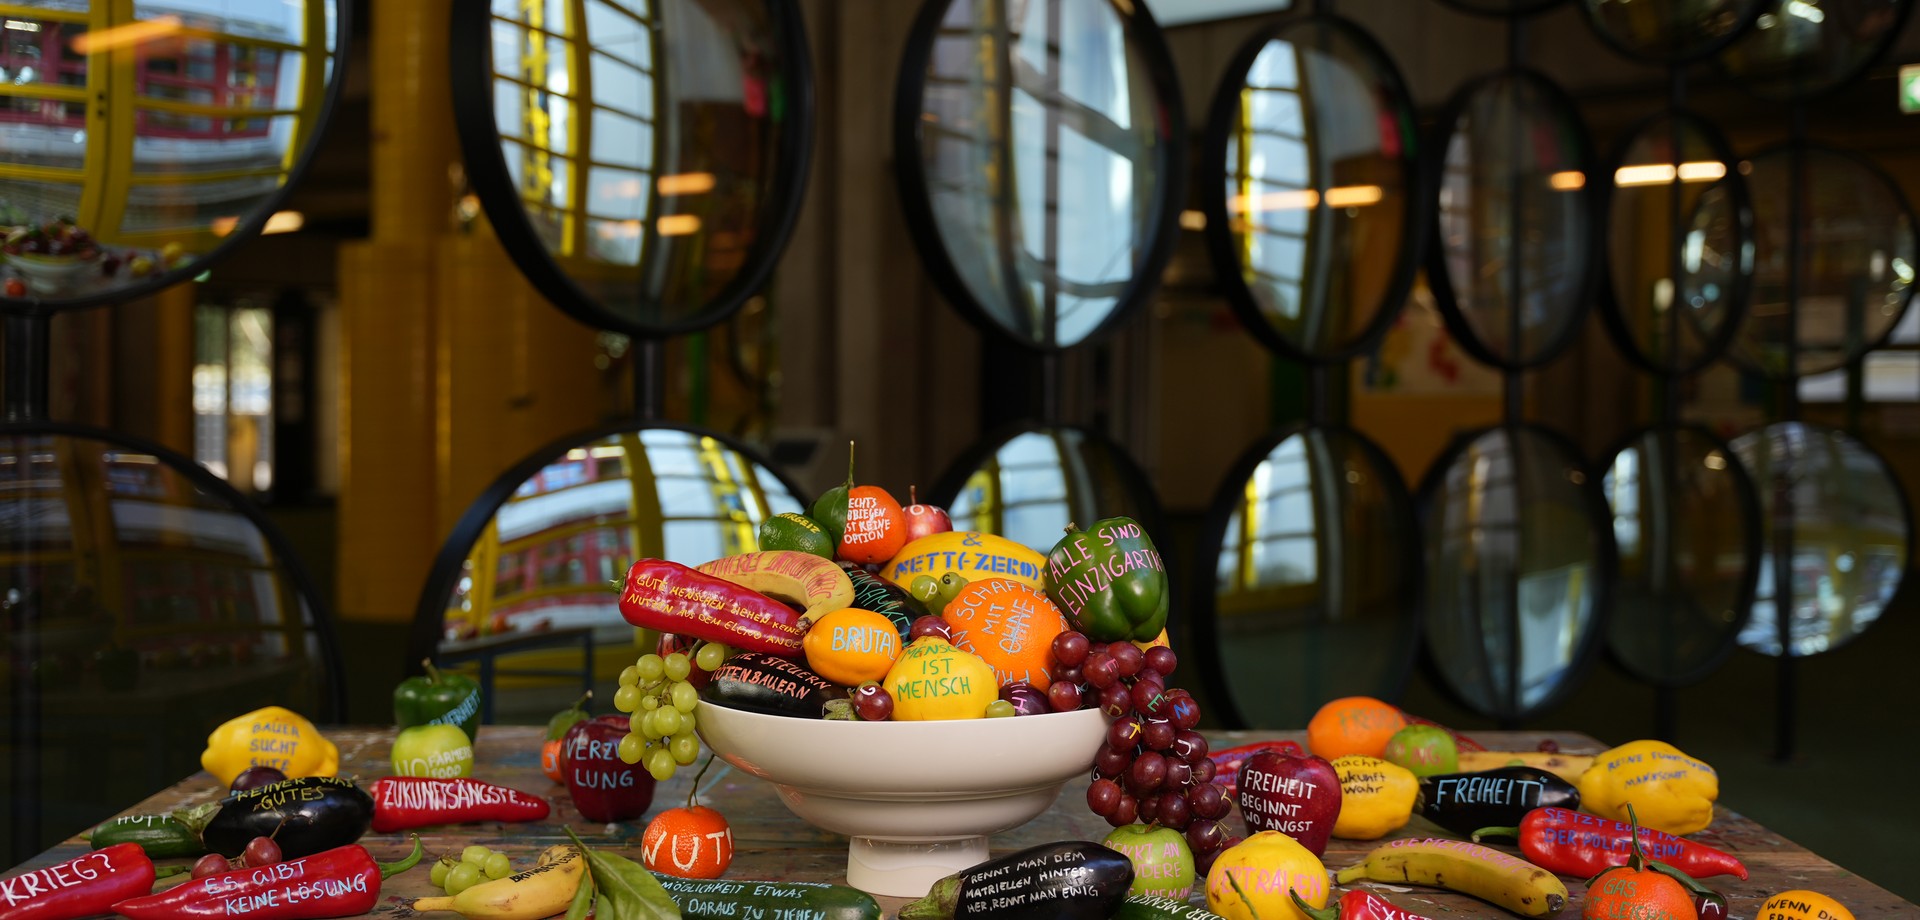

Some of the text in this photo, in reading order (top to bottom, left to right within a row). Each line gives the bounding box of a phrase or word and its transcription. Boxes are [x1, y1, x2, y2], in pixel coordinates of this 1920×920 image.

[847, 507, 886, 521] BBIEGEN
[848, 497, 877, 508] ECHTS
[843, 529, 884, 545] OPTION
[859, 518, 891, 532] KEINE
[1049, 523, 1141, 584] ALLE SIND
[636, 575, 668, 591] GUTE
[669, 586, 726, 611] MENSCHEN
[626, 593, 674, 613] NUTZEN
[676, 609, 696, 620] AUS
[698, 613, 721, 626] DEM
[981, 602, 1006, 635] MIT
[831, 626, 897, 661] BRUTAL
[901, 643, 957, 661] MENSC
[760, 656, 831, 690] STEUERN
[921, 657, 954, 675] IST
[749, 671, 811, 700] BAUERN
[897, 676, 971, 702] MENSCH
[252, 721, 300, 739] BAUER
[250, 738, 299, 757] SUCHT
[237, 777, 306, 802] KEINER
[575, 768, 634, 790] LUNG
[1244, 769, 1317, 800] FREIHEIT
[1343, 784, 1384, 795] wahr
[261, 785, 325, 810] GUTES
[1241, 792, 1303, 817] BEGINNT
[1243, 810, 1313, 833] WO ANGST
[1544, 807, 1608, 827] SETZT
[642, 826, 733, 872] WUT!
[1163, 841, 1180, 859] AN
[1544, 828, 1577, 846] DER
[1653, 843, 1685, 859] EIN!
[0, 853, 116, 907] KRIEG?
[205, 859, 307, 895] ES GIBT
[970, 851, 1086, 885] RENNT MAN DEM
[1131, 861, 1182, 879] NDERE
[661, 881, 745, 894] MÖGLICHKEIT
[753, 884, 808, 898] ETWAS
[966, 875, 1032, 899] MATRIELLEN
[1029, 887, 1057, 903] MAN
[1061, 884, 1099, 899] EWIG
[1210, 865, 1322, 899] VERTRAUEN
[1603, 877, 1637, 898] GAS
[225, 873, 367, 916] KEINE LÖSUNG
[1766, 899, 1812, 914] WENN
[688, 898, 738, 916] DARAUS
[742, 905, 765, 920] ZU
